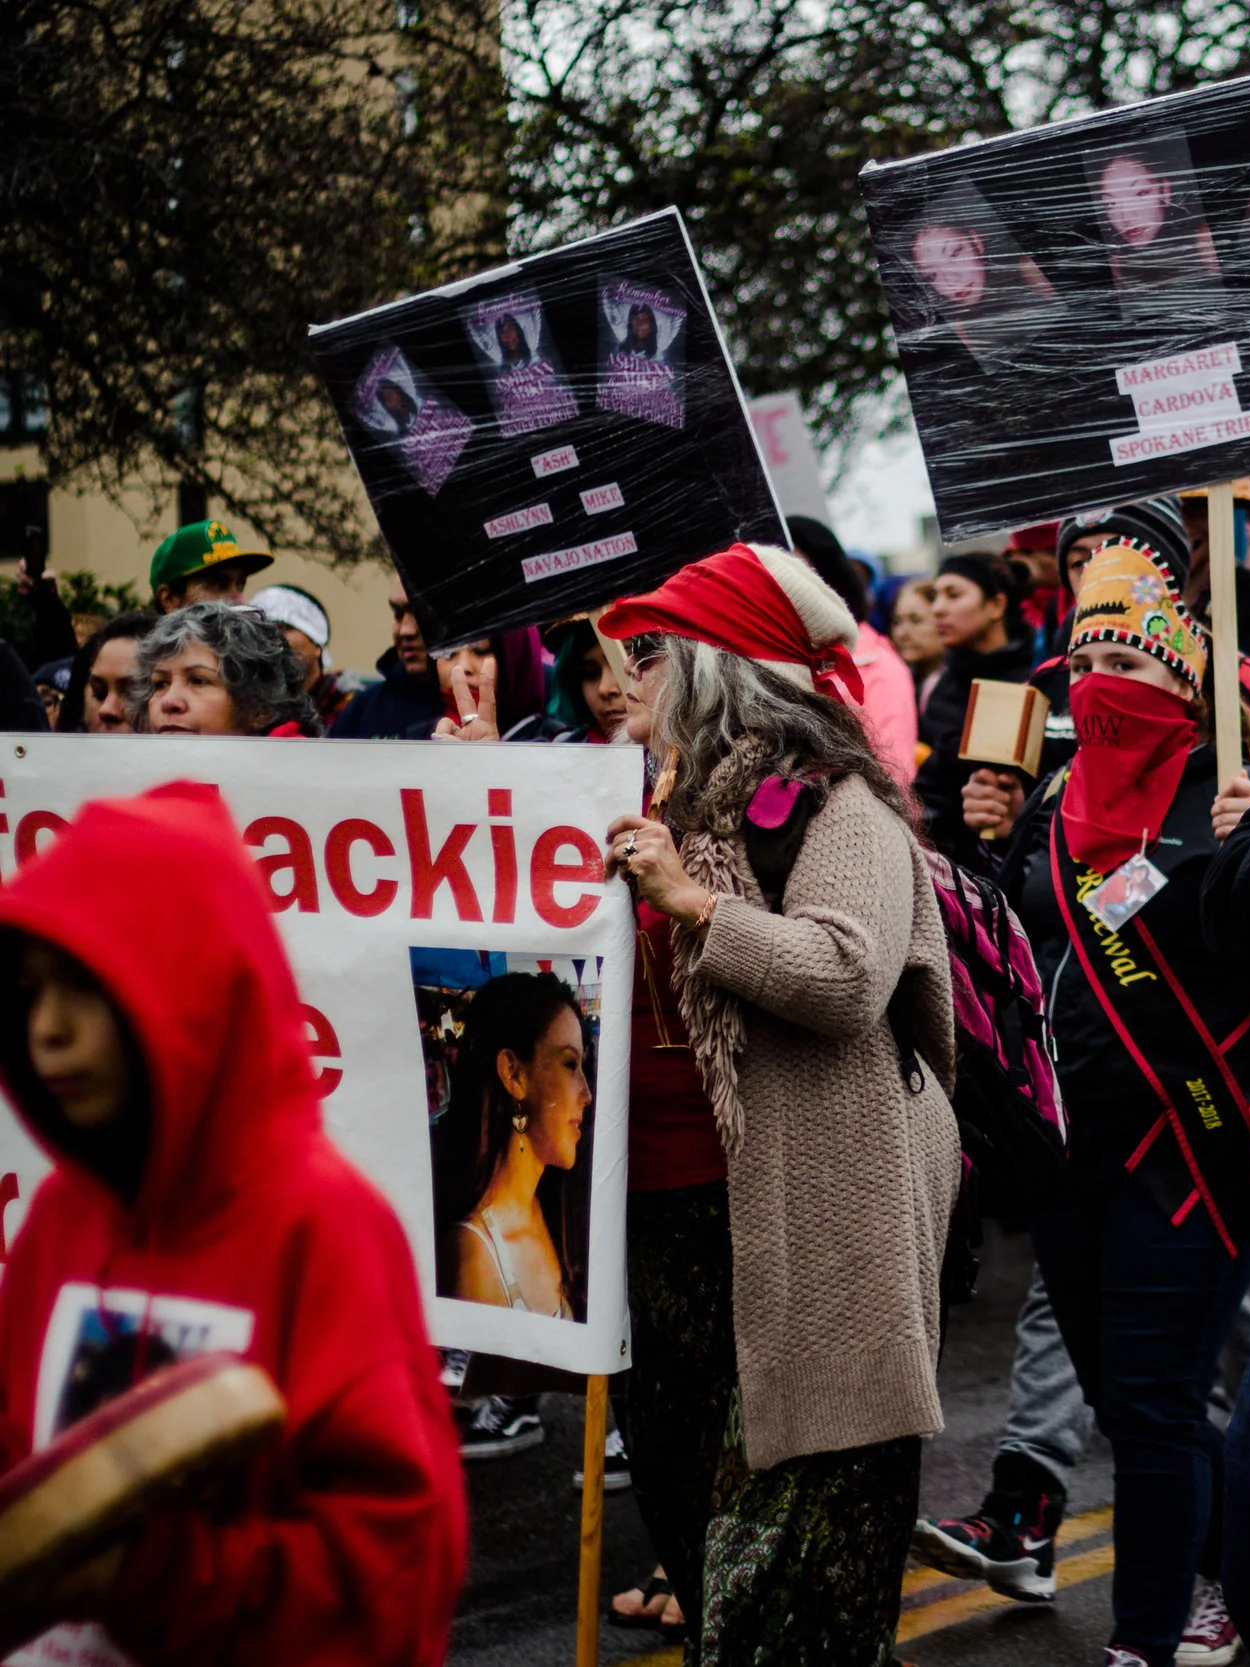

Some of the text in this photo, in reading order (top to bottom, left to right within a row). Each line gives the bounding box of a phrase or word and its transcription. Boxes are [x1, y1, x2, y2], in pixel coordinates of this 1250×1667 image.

[1122, 347, 1235, 388] MARGARET
[1138, 383, 1233, 418] CARDOVA
[1116, 426, 1209, 461] SPOKANE
[585, 487, 621, 510] MIKE
[488, 505, 552, 537] ASHLYNN
[523, 535, 636, 577] NAVAJO NATION
[205, 782, 606, 930] ackie
[1185, 1077, 1223, 1130] 2017-2018
